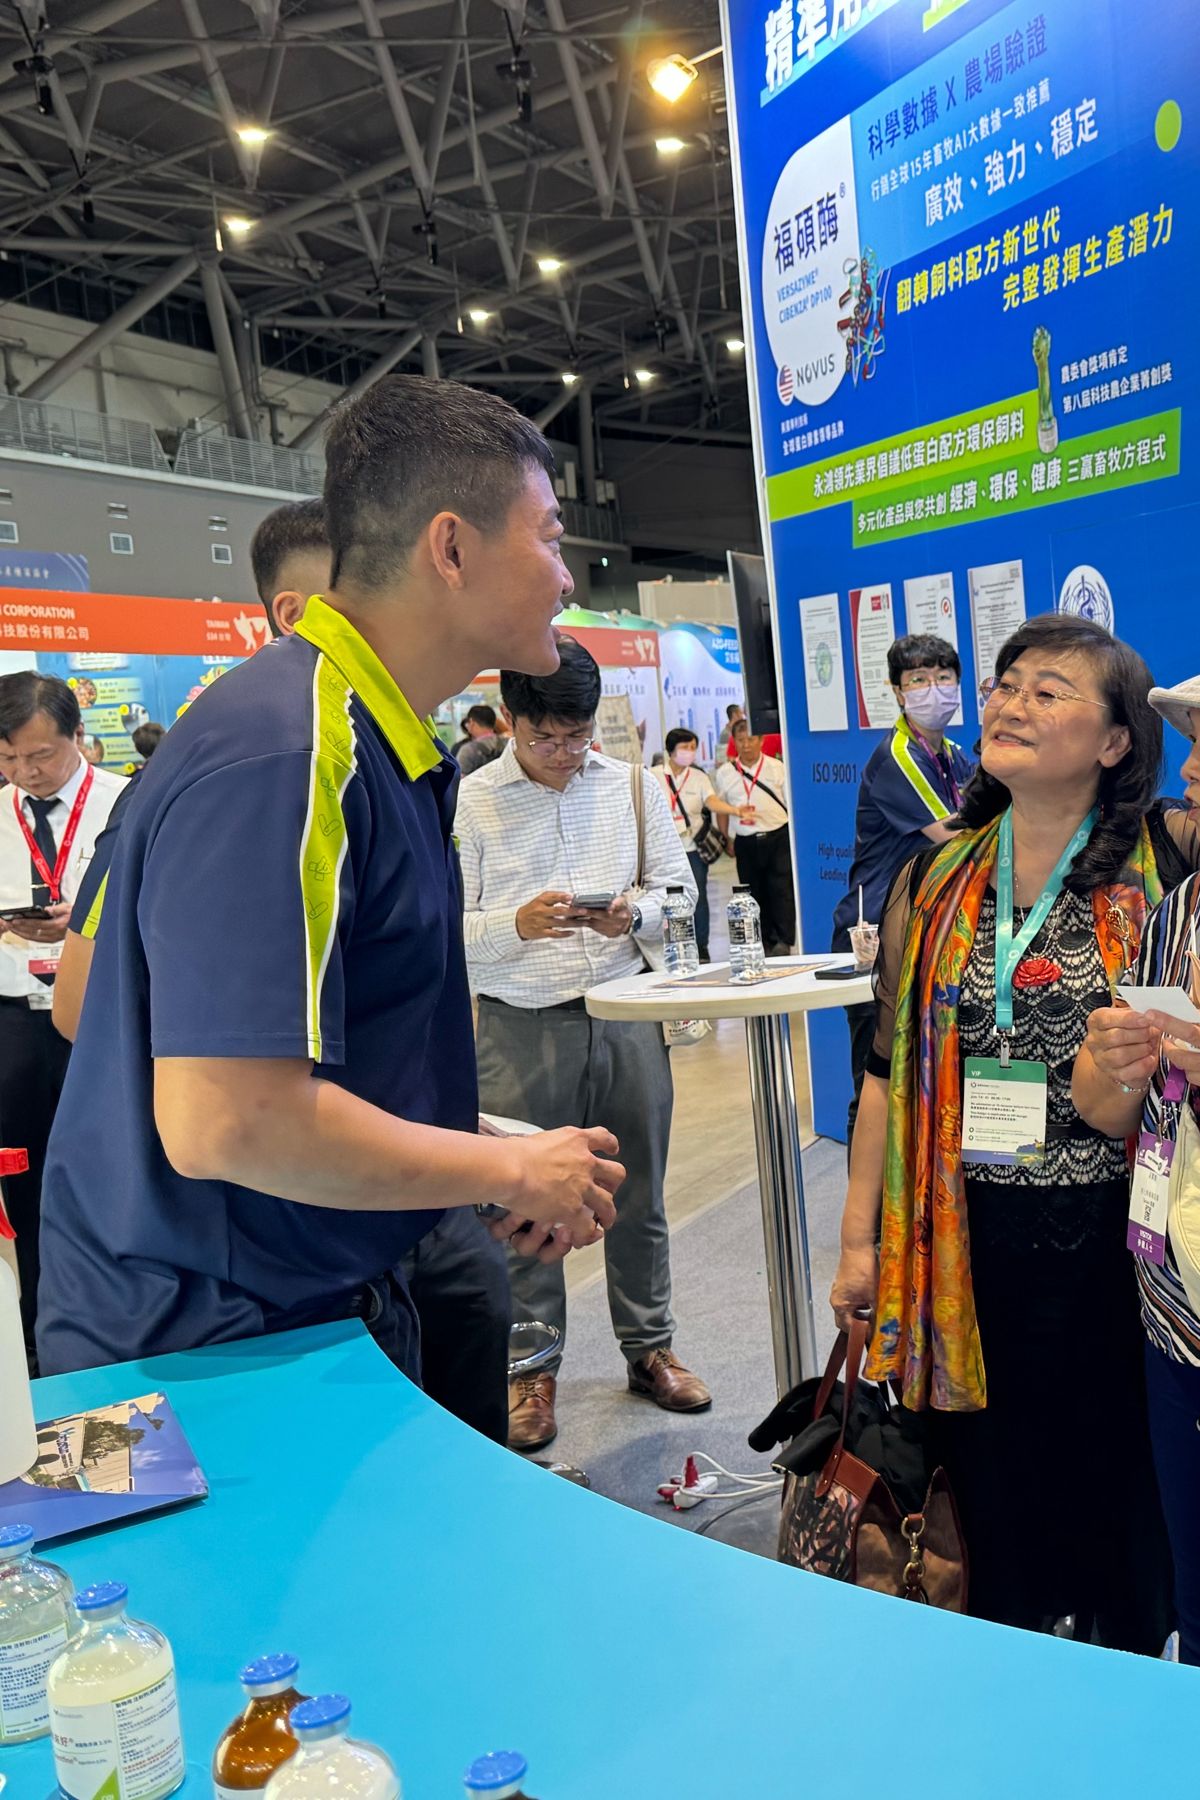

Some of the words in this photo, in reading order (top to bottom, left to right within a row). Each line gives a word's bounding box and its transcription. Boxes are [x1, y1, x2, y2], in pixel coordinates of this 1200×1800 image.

[765, 0, 880, 93] 精準用
[868, 86, 939, 160] 科學數據
[964, 13, 1047, 102] 農場驗證
[924, 98, 1098, 228] 廣效、強力、穩定
[811, 285, 832, 308] DP100
[896, 205, 1061, 314] 翻轉飼料配方新世代
[1003, 202, 1174, 312] 完整發揮生產潛力
[796, 353, 835, 387] NOVUS
[814, 408, 1025, 498] 永鴻領先業界倡議低蛋白配方環保飼料
[857, 491, 947, 534] 多元化產品與您共創
[950, 457, 1062, 513] 經濟、環保、健康
[1066, 433, 1167, 483] 三贏畜牧方程式
[0, 623, 89, 641] 技股份有限公司
[3, 604, 76, 620] CORPORATION
[812, 763, 830, 783] ISO
[831, 763, 857, 783] 9001
[817, 843, 834, 859] High
